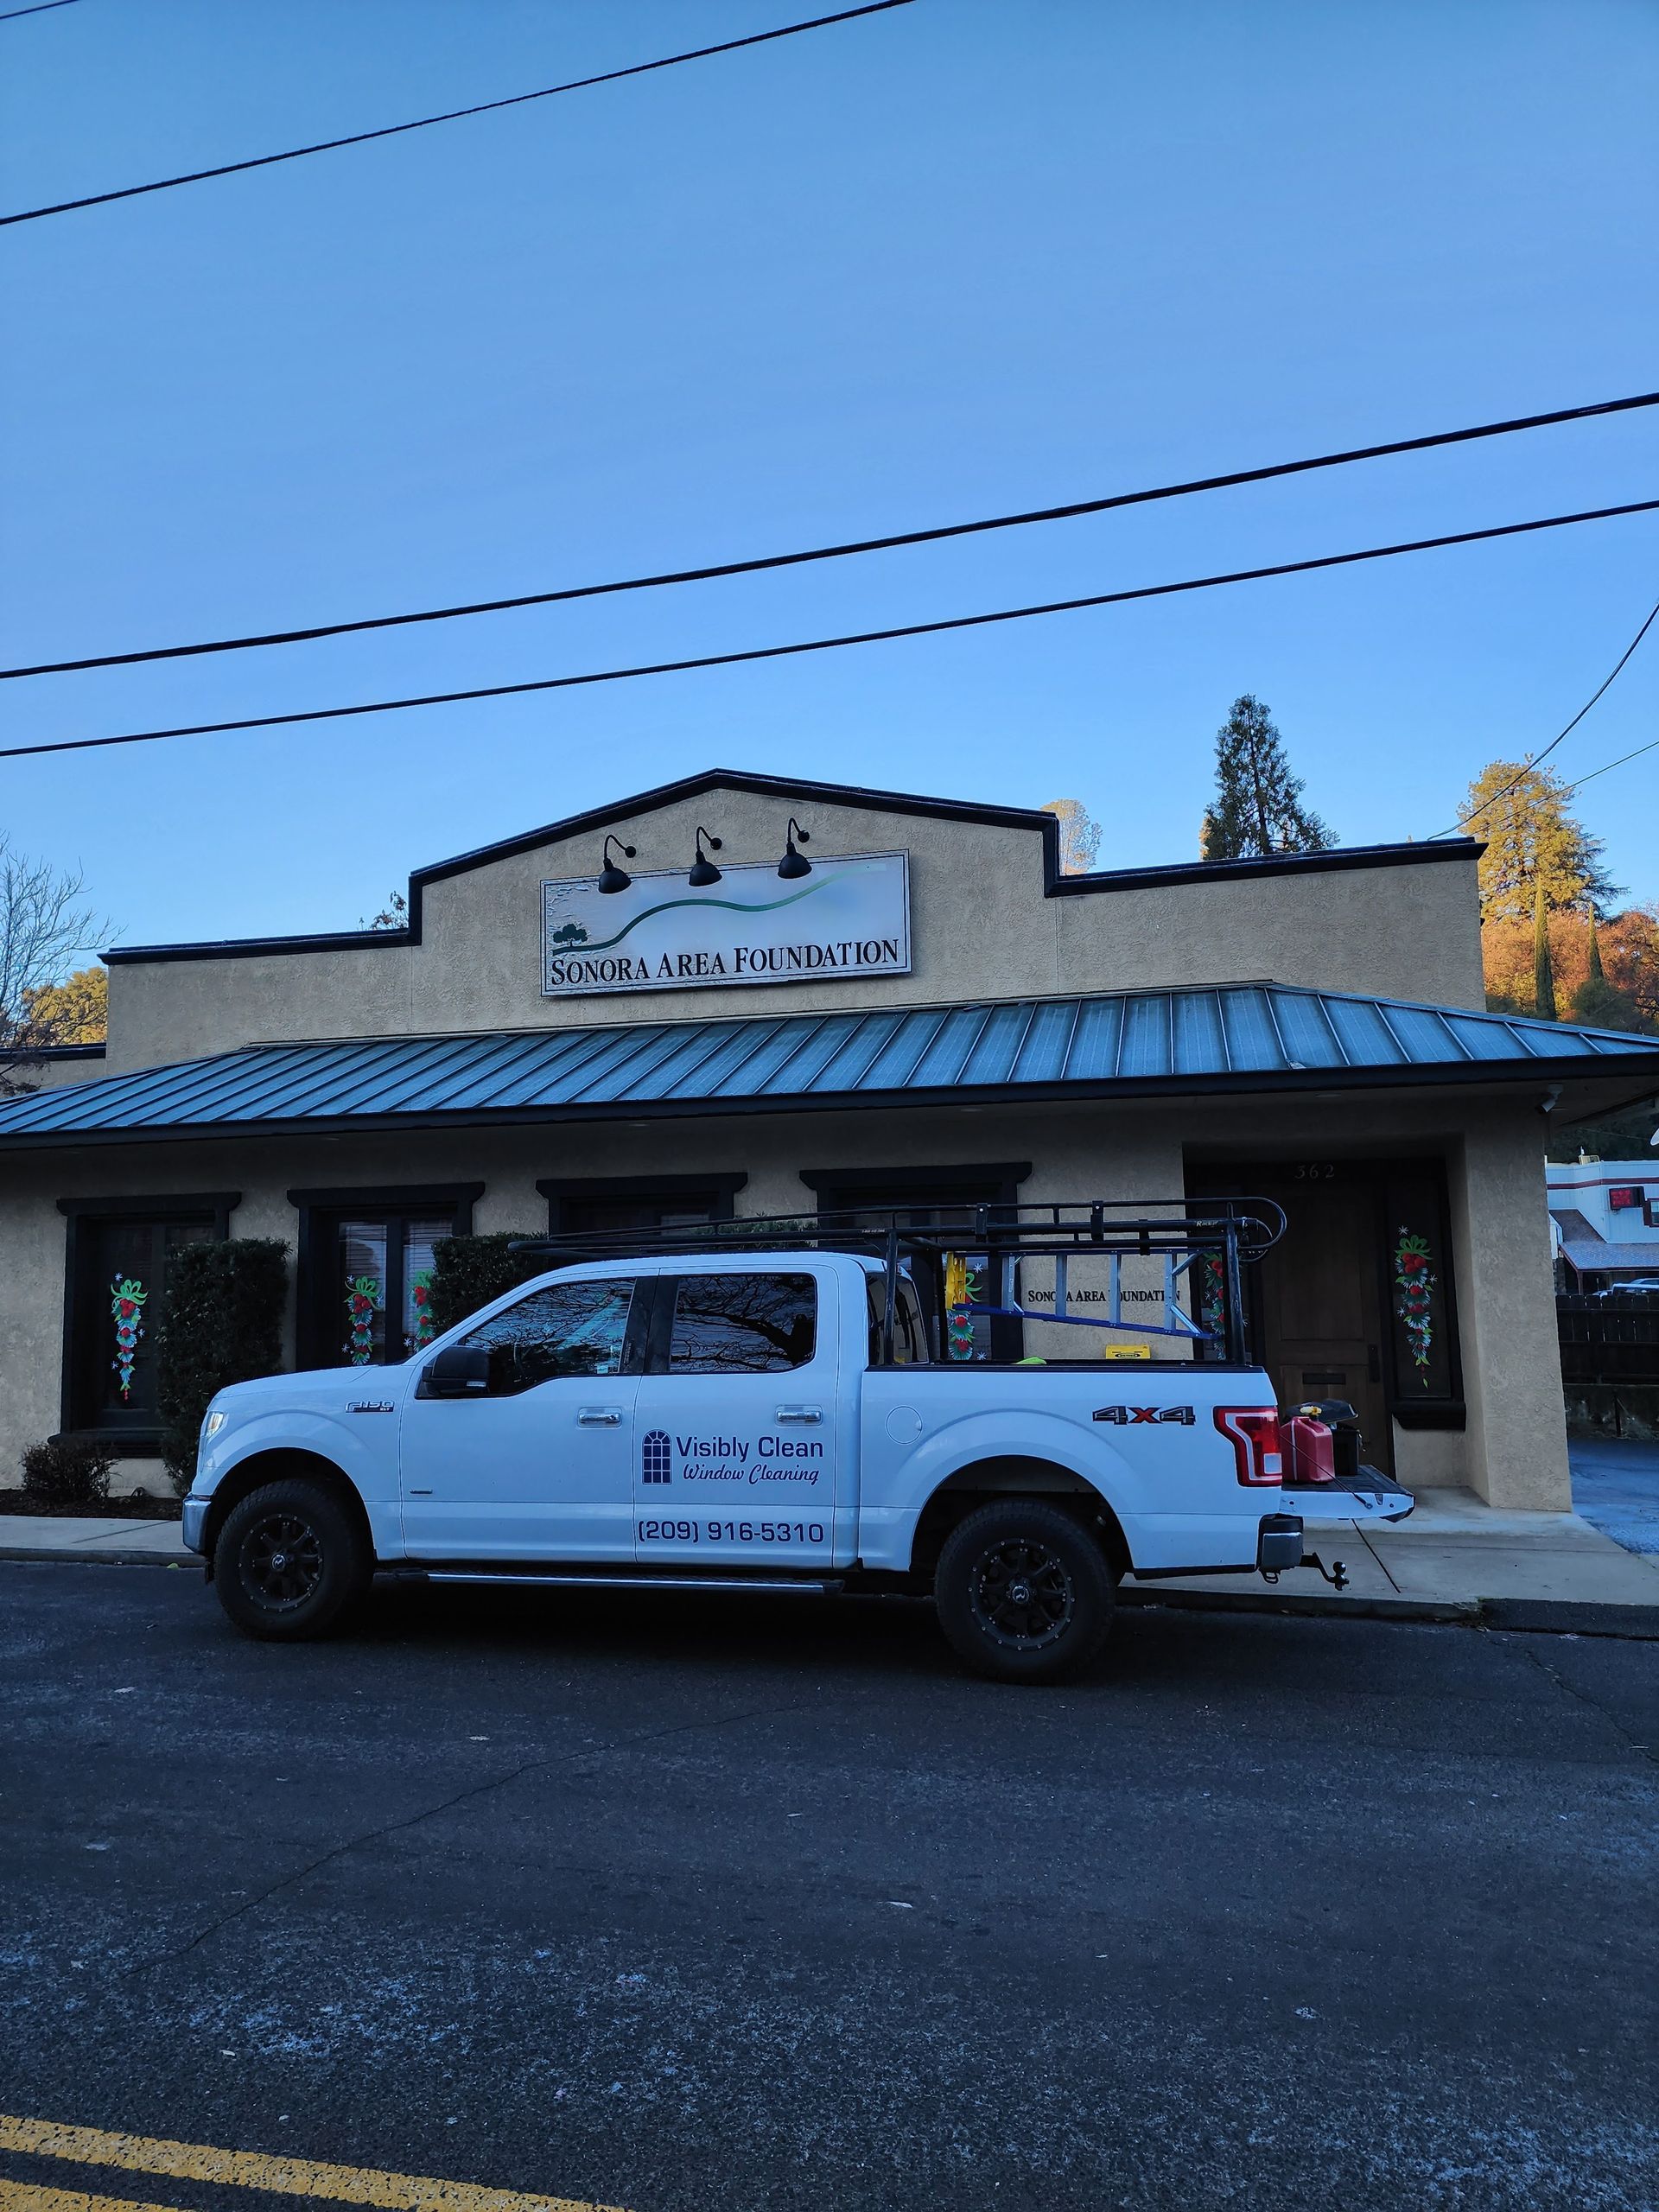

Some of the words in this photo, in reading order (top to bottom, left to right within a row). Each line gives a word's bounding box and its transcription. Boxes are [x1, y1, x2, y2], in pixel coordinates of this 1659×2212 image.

[551, 957, 650, 985] SONORA
[657, 952, 726, 978] AREA
[734, 939, 899, 973] FOUNDATION
[1294, 1163, 1335, 1179] 362
[1027, 1290, 1073, 1302] SONOA
[1076, 1290, 1107, 1302] AREA
[1108, 1289, 1180, 1302] UNDATIN
[676, 1436, 750, 1463] Visibly
[758, 1436, 823, 1458] Clean
[683, 1463, 745, 1481] Window
[748, 1464, 820, 1486] Cleaning
[638, 1521, 699, 1542] (209)
[708, 1522, 824, 1543] 916-5310
